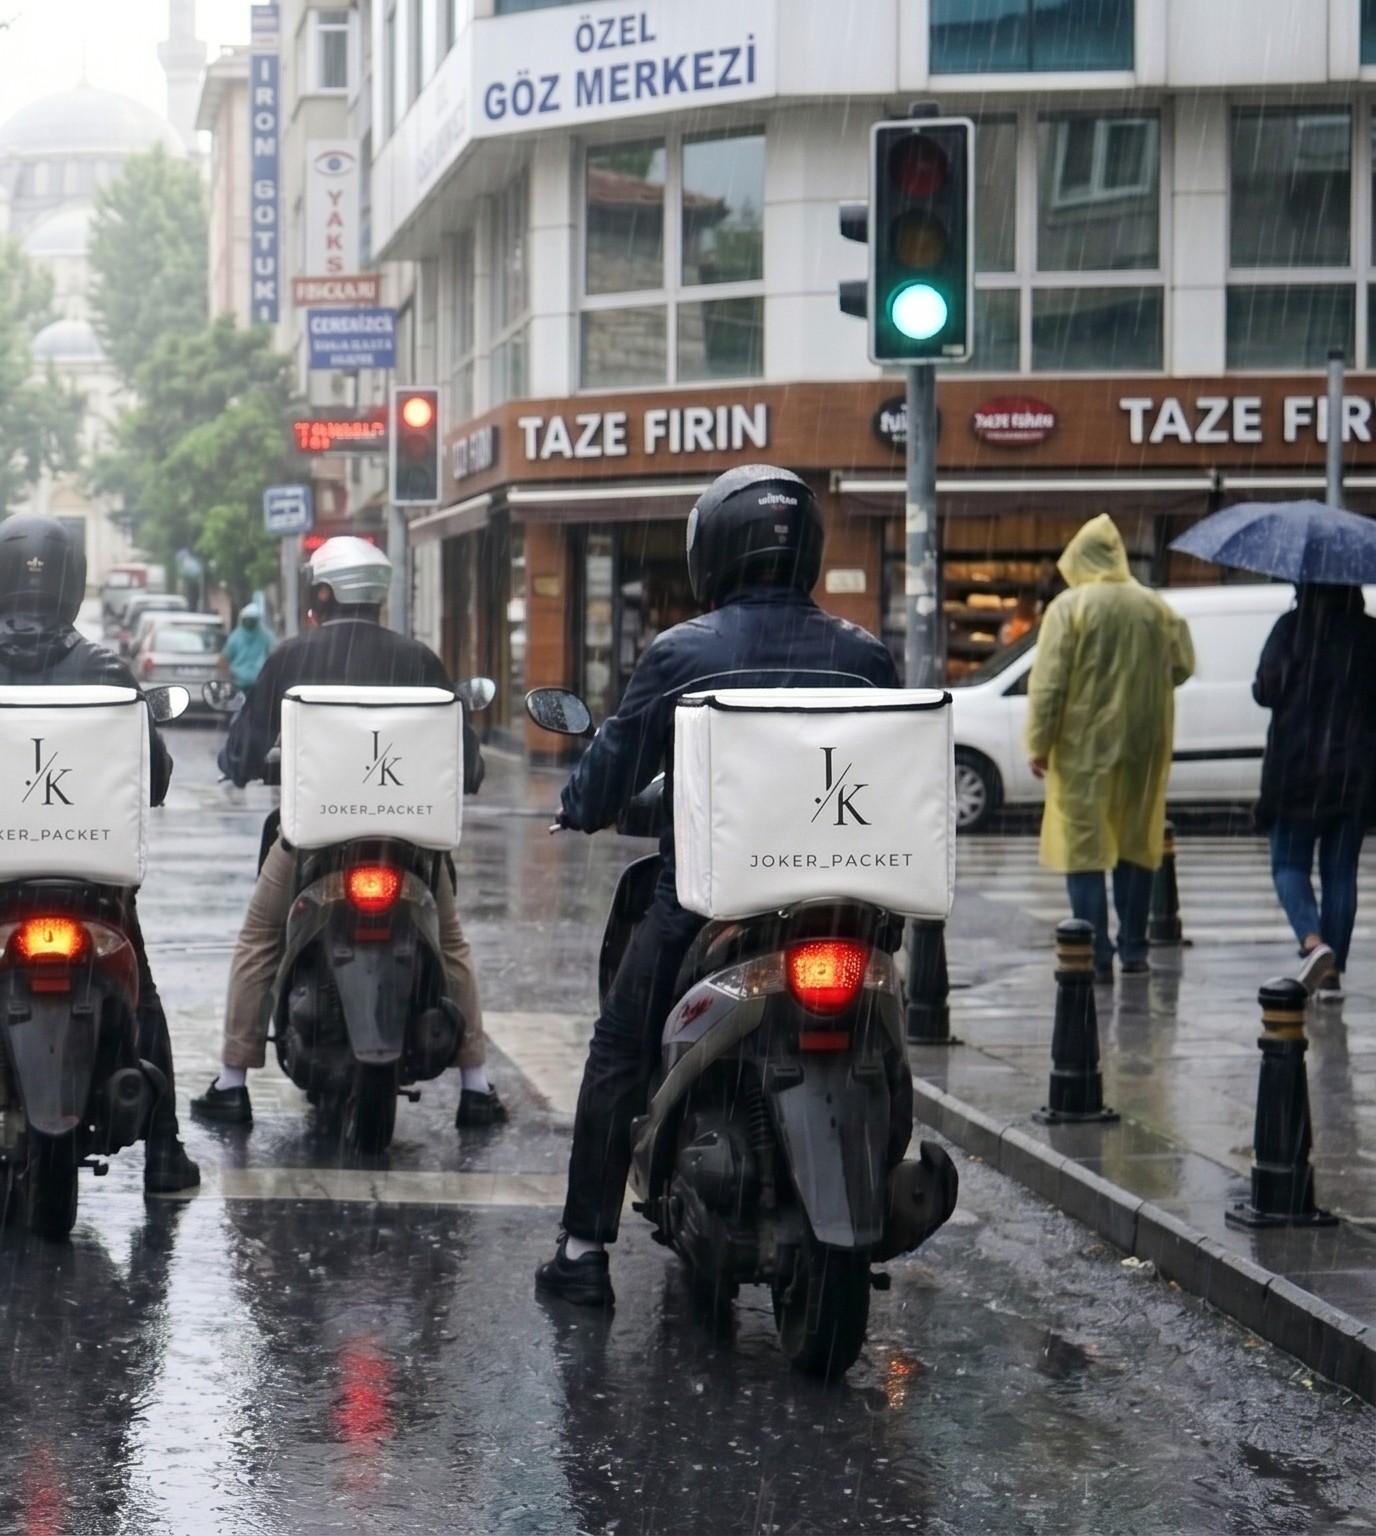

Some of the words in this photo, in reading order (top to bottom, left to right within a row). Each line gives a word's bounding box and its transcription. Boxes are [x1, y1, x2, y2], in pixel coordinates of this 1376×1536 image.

[575, 13, 656, 53] ÖZEL
[484, 71, 560, 121] GÖZ
[575, 33, 756, 108] MERKEZİ
[518, 410, 628, 461] TAZE
[643, 402, 768, 455] FIRIN
[1120, 396, 1263, 443] TAZE
[1283, 395, 1376, 443] FIR
[320, 804, 433, 816] JOKER_PACKET
[750, 852, 914, 869] JOKER_PACKET
